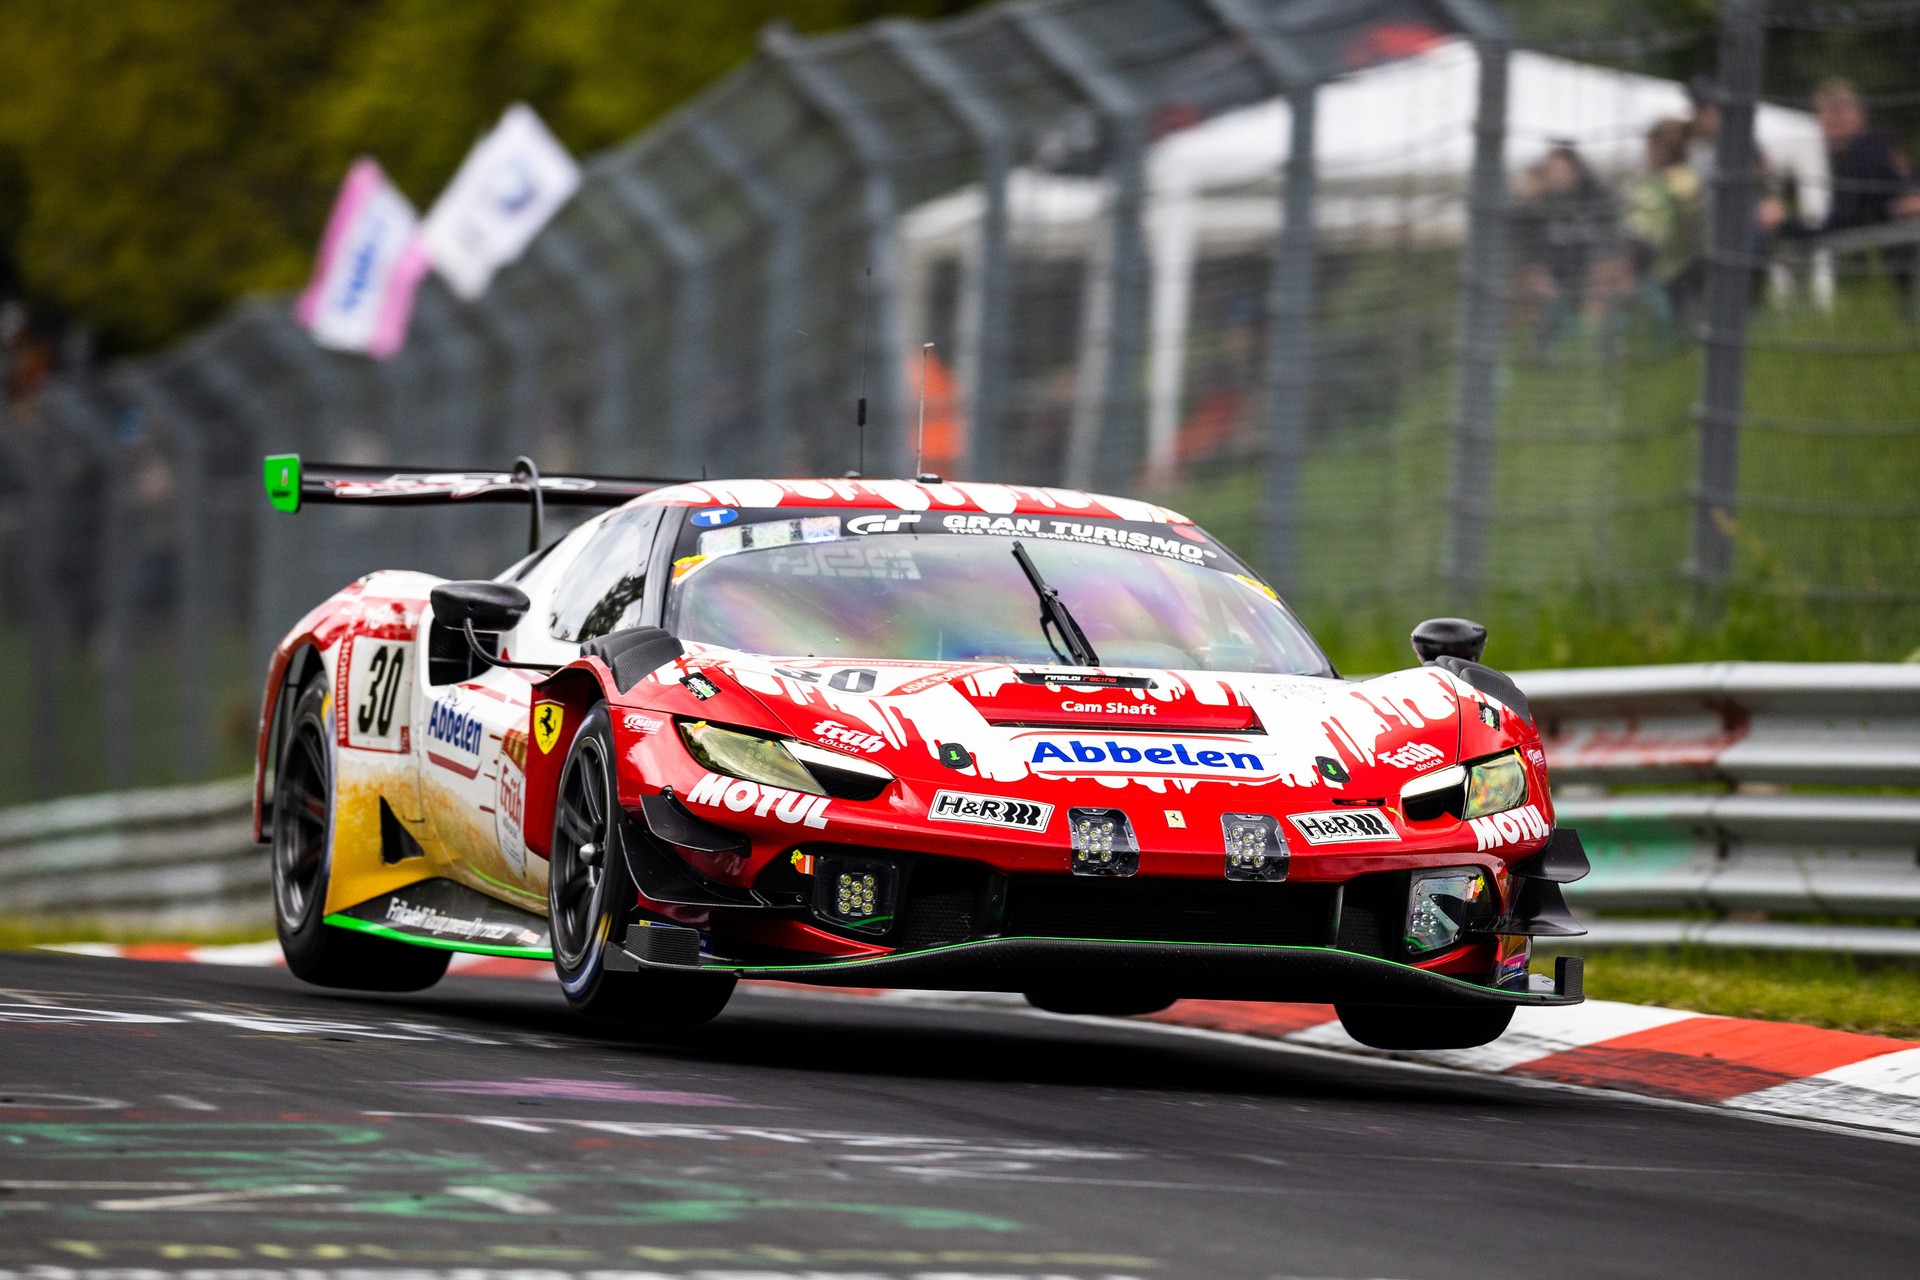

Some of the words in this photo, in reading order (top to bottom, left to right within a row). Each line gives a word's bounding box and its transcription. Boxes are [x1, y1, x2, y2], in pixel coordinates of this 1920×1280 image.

[942, 514, 1041, 532] GRAN
[1050, 521, 1204, 559] TURISMO
[947, 527, 984, 535] THE
[987, 528, 1034, 537] REAL
[1035, 531, 1106, 545] DRIVING
[1108, 540, 1205, 566] SIMULATOR
[357, 645, 404, 737] 30
[1061, 700, 1102, 713] Cam
[1105, 702, 1157, 716] Shaft
[427, 700, 482, 756] Abbelen
[817, 736, 860, 754] KÖLSCH
[1031, 740, 1265, 771] Abbelen
[1414, 757, 1444, 772] KÖLSCH
[686, 771, 833, 830] MOTUL
[937, 795, 1003, 817] H&R
[1304, 815, 1354, 837] H&R
[1467, 804, 1550, 852] MOTUL
